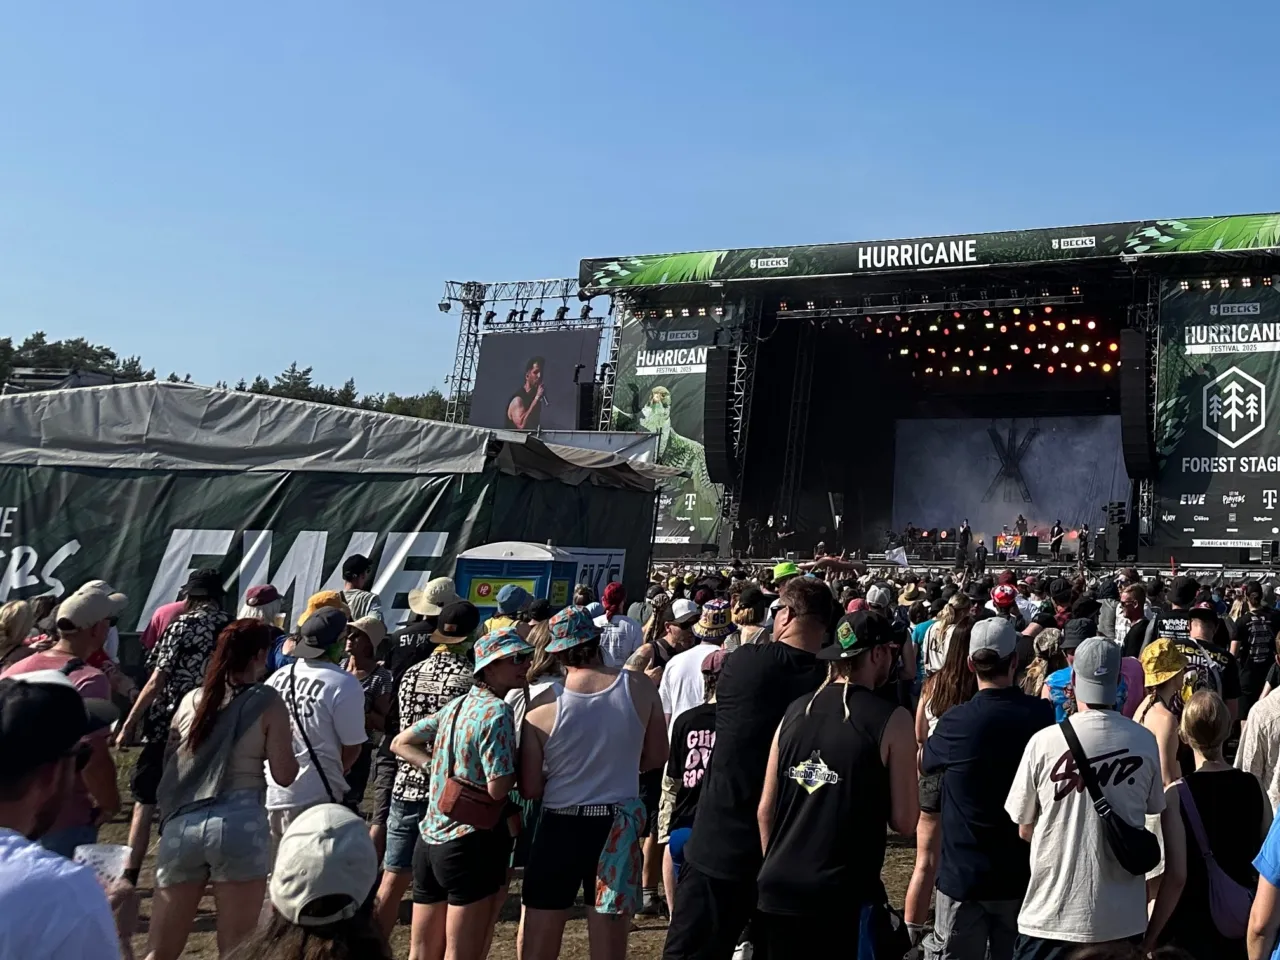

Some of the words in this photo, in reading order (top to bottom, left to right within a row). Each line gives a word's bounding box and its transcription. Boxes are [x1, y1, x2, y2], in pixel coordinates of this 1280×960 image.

[1062, 239, 1094, 248] BECK'S
[858, 239, 977, 268] HURRICANE
[758, 258, 788, 267] BECK'S
[1222, 304, 1259, 314] BECK'S
[669, 331, 698, 340] BECK'S
[1211, 344, 1240, 352] FESTIVAL
[636, 347, 708, 367] HURRICAN
[1182, 457, 1236, 473] FOREST
[1180, 494, 1206, 505] EWE
[136, 529, 449, 634] EWE
[400, 633, 414, 647] SV
[273, 672, 326, 698] GOOD
